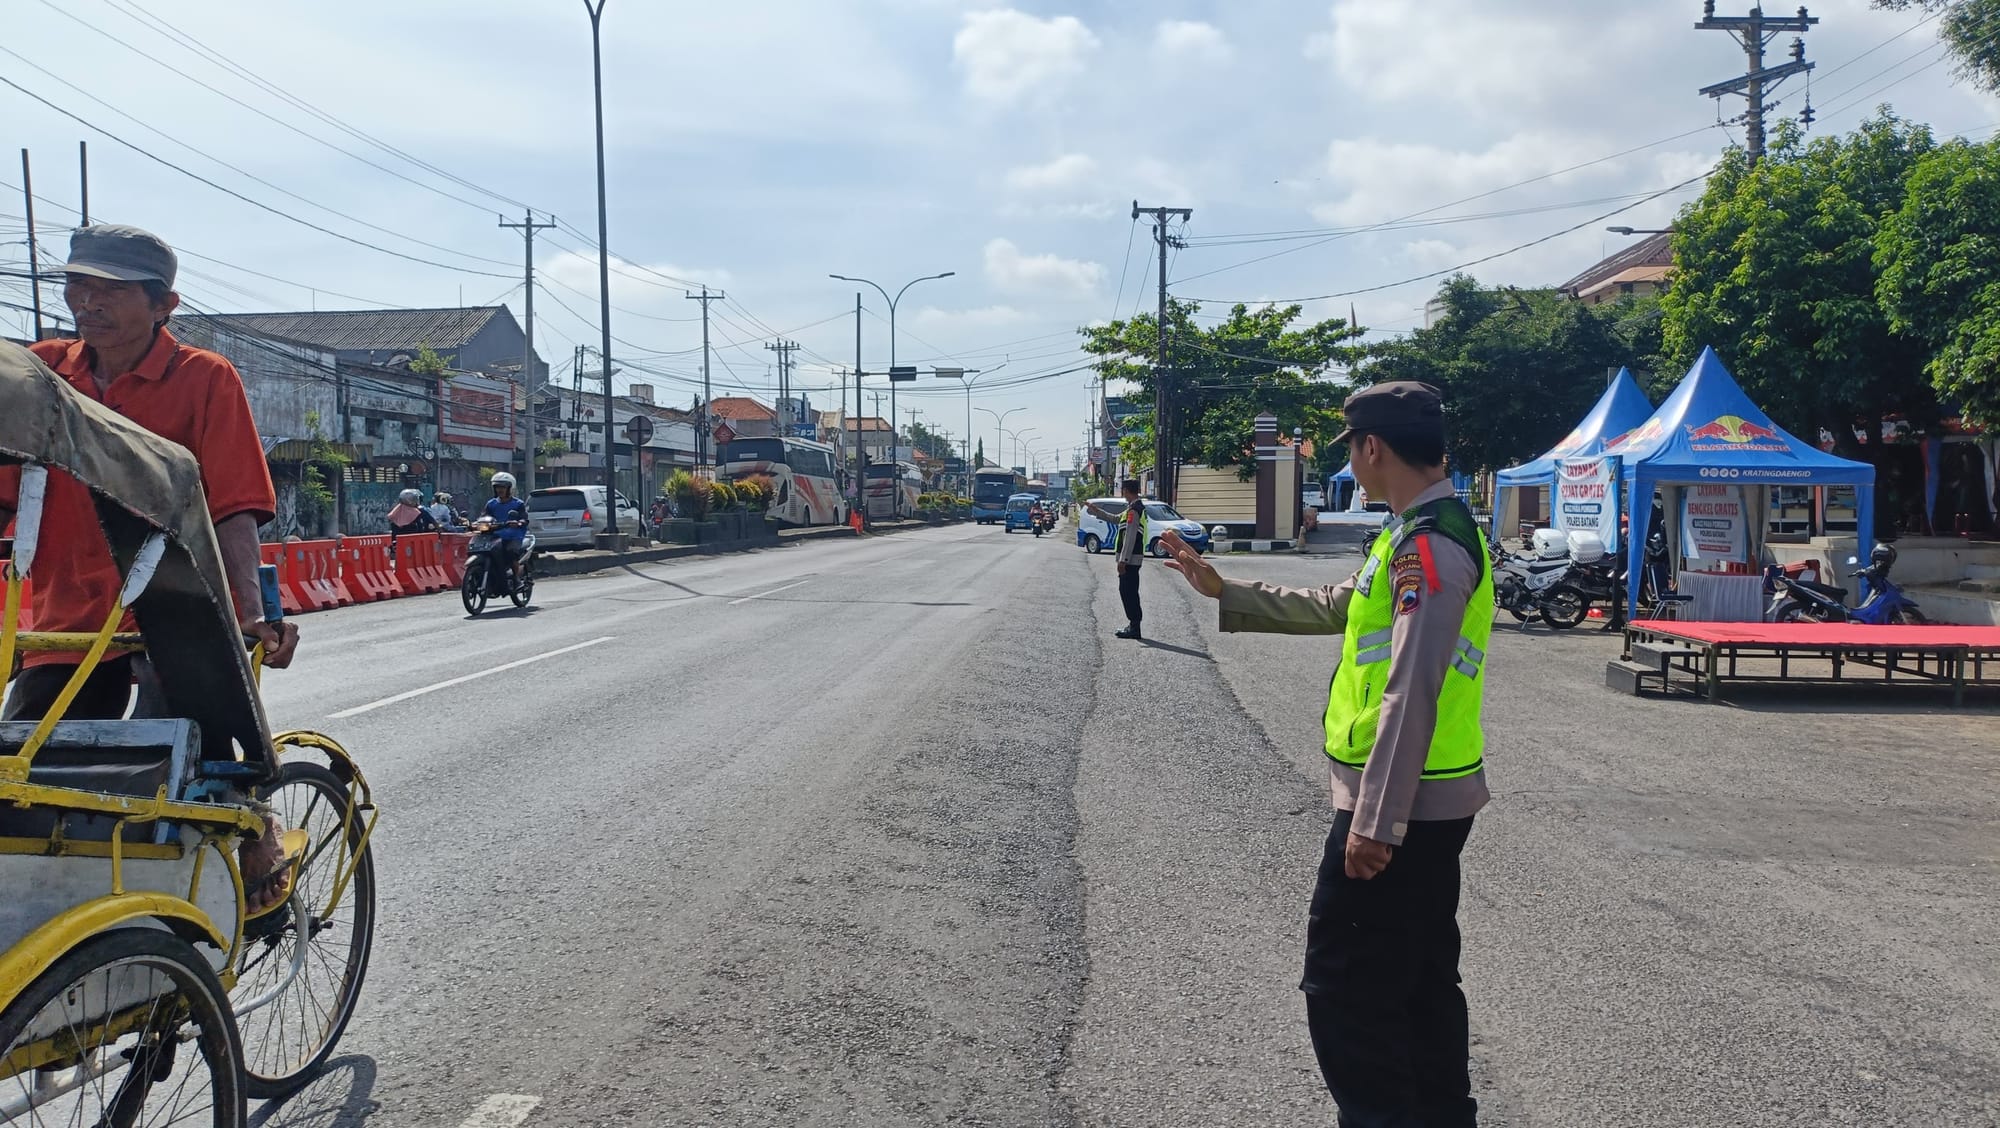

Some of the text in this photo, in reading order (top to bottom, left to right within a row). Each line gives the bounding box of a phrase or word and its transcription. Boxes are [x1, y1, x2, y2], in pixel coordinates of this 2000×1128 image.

[1742, 470, 1811, 478] KRATINGDAENGID
[1688, 503, 1738, 516] BENGKEL GRATIS
[1581, 516, 1599, 528] BATANG
